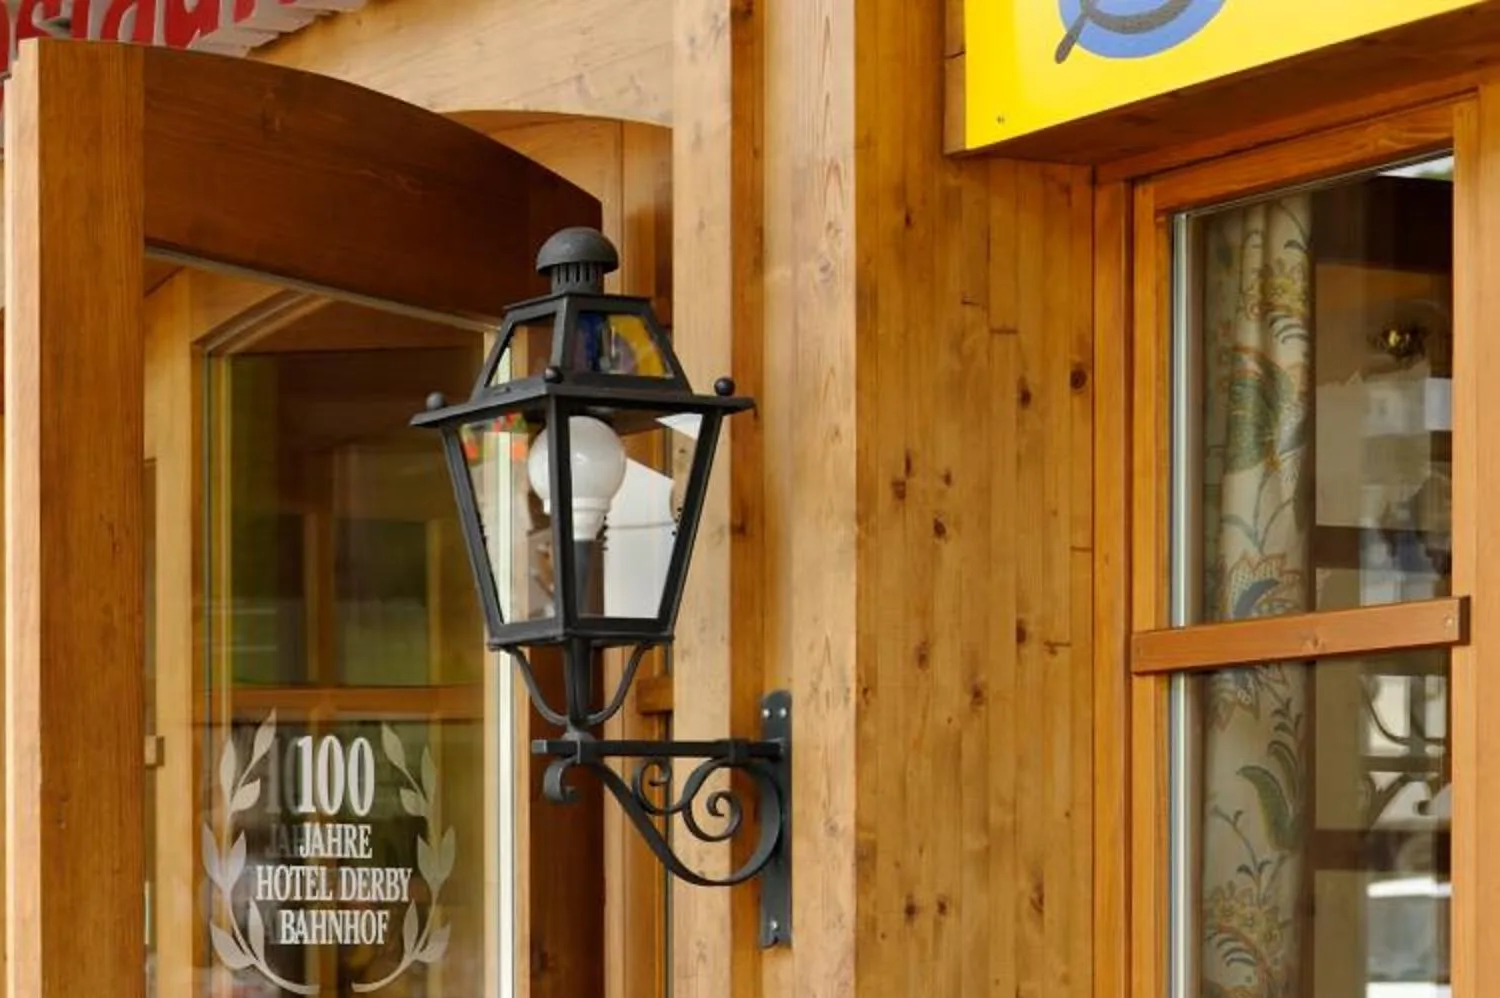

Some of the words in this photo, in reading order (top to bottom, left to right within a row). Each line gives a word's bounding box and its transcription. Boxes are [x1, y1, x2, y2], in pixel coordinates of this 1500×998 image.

[297, 735, 375, 816] 100
[300, 823, 372, 859] JAHRE
[255, 865, 333, 901] HOTEL
[340, 867, 413, 902] DERBY
[279, 909, 389, 945] BAHNHOF
